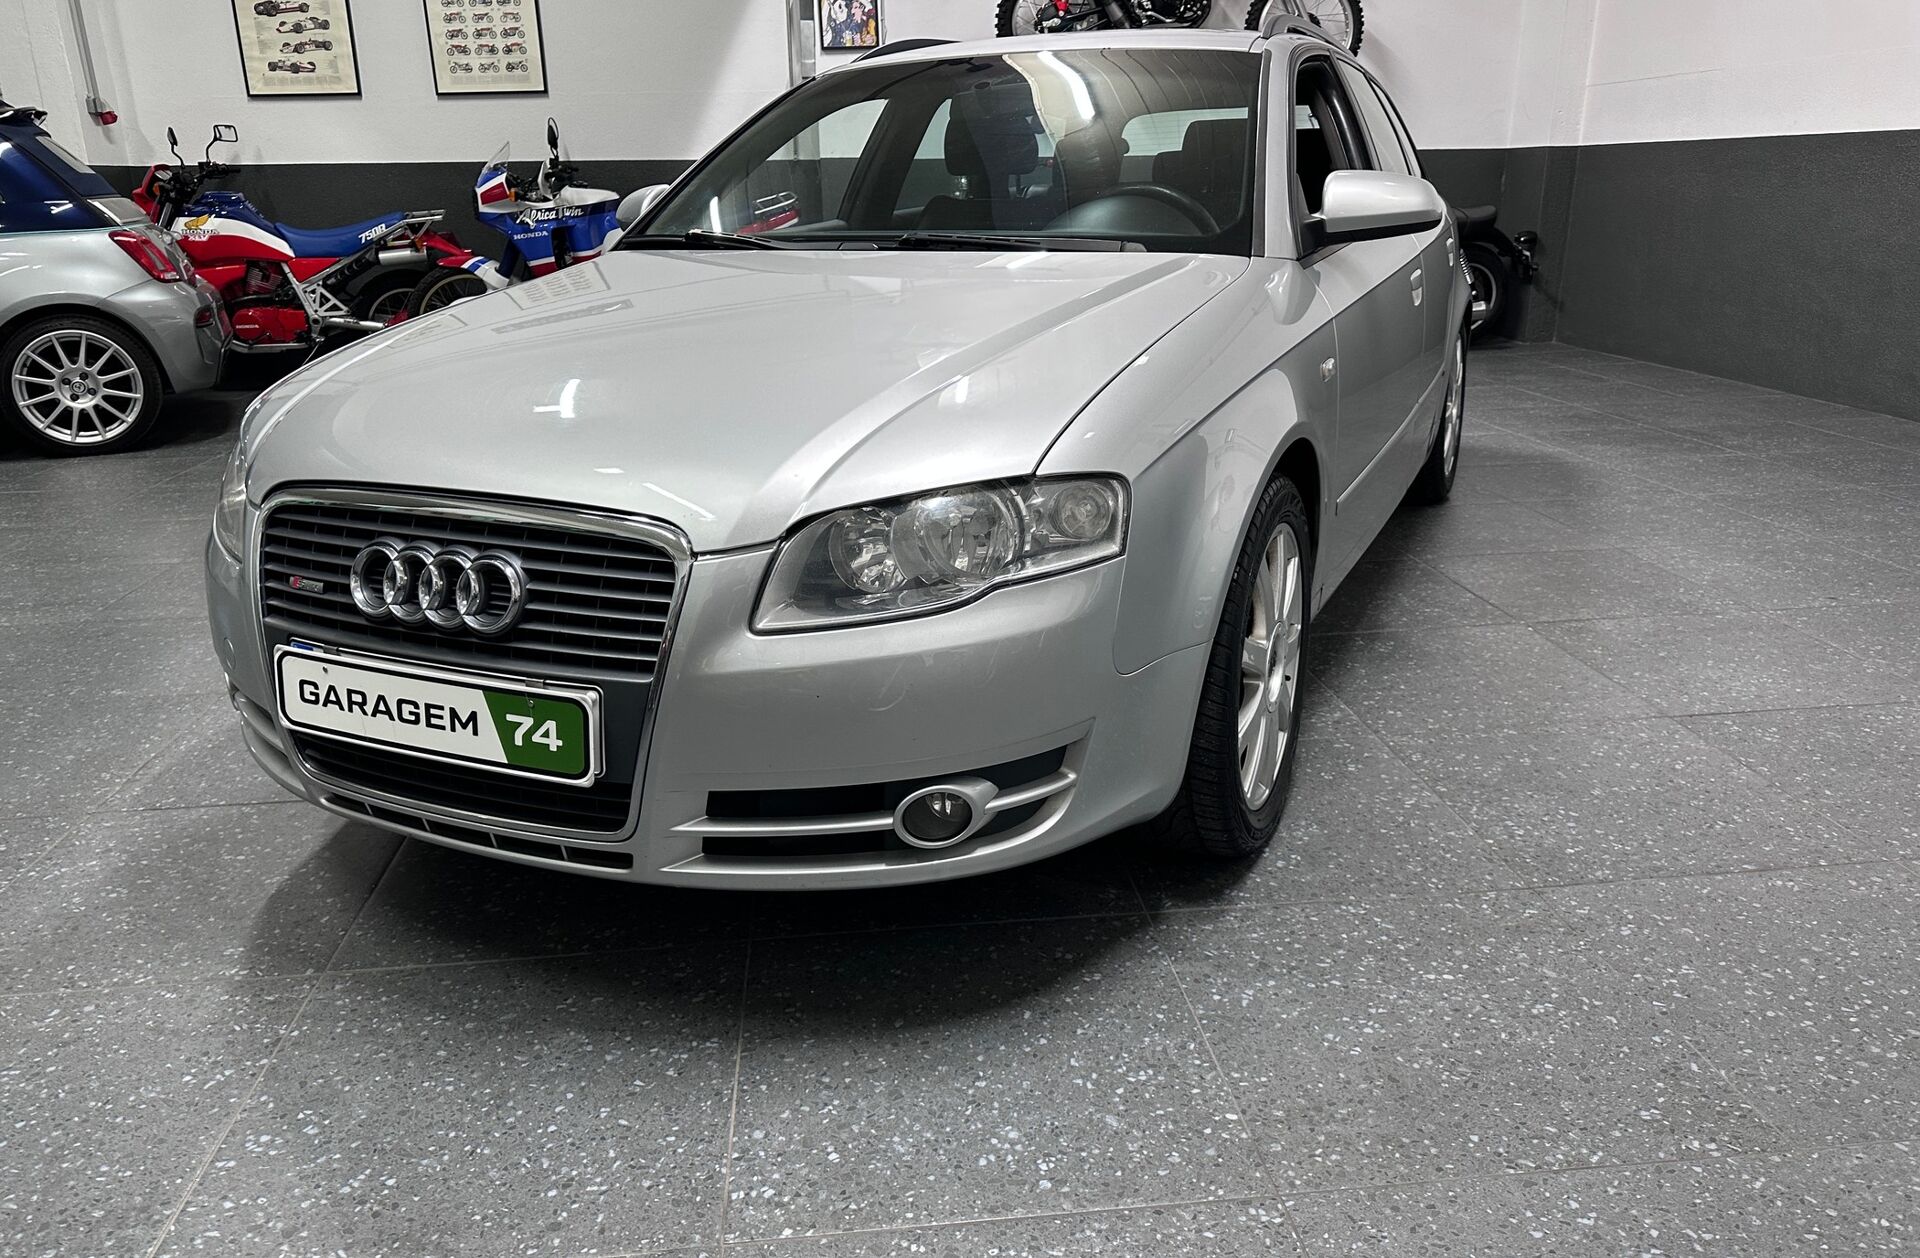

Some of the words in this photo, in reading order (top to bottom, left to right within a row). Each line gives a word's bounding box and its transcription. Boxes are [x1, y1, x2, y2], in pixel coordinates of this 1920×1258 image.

[515, 207, 558, 229] Africa
[555, 205, 584, 219] Twin
[358, 223, 386, 244] 750R
[513, 230, 548, 240] HONDA
[298, 679, 479, 737] GARAGEM
[505, 713, 562, 752] 74
